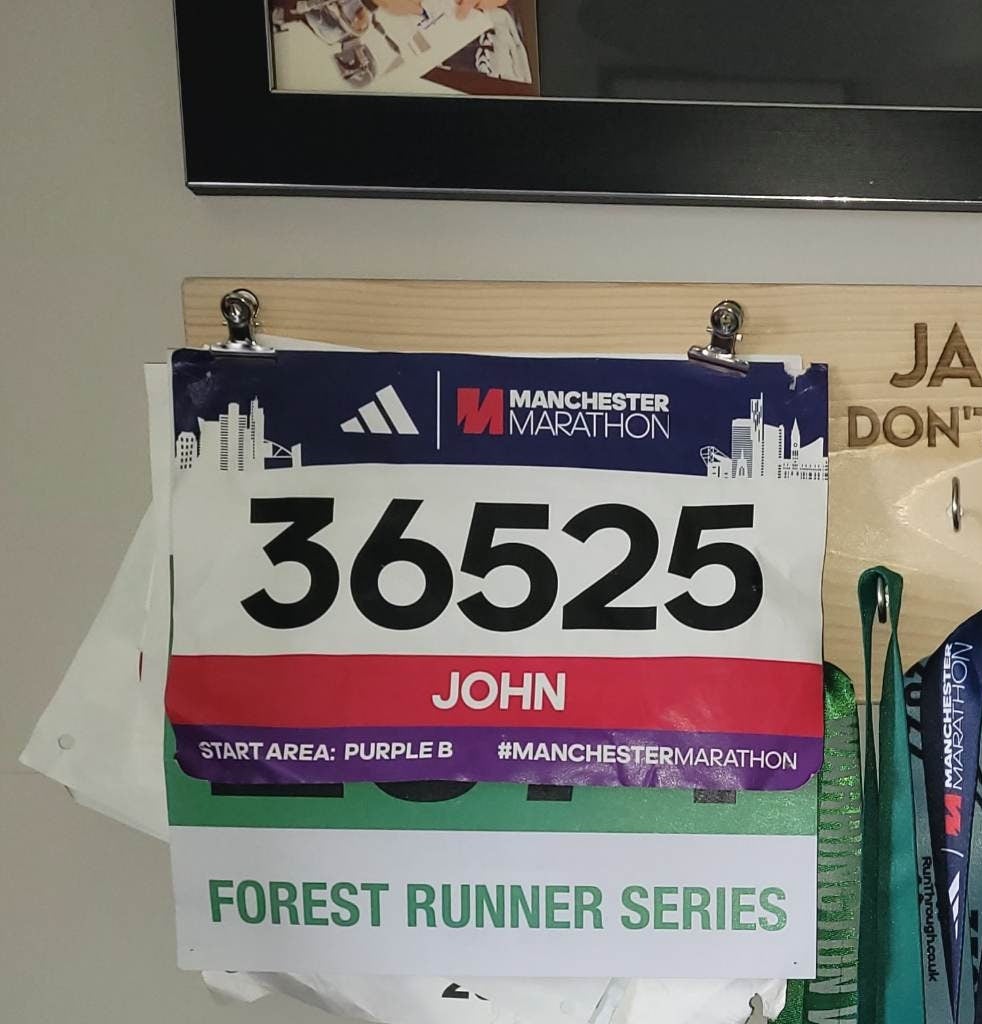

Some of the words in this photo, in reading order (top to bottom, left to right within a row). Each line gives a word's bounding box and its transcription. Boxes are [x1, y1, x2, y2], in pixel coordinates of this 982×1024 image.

[509, 389, 670, 413] MANCHESTER
[509, 410, 670, 439] MARATHON
[240, 496, 765, 631] 36525
[431, 670, 567, 711] JOHN
[942, 643, 953, 789] MANCHESTER
[951, 641, 974, 791] MARATHON
[199, 741, 263, 760] START
[265, 742, 336, 761] AREA:
[344, 741, 434, 761] PURPLE
[437, 741, 454, 758] B
[497, 741, 798, 770] #MANCHESTERMARATHON
[208, 878, 389, 928] FOREST
[405, 882, 604, 931] RUNNER
[620, 884, 788, 933] SERIES
